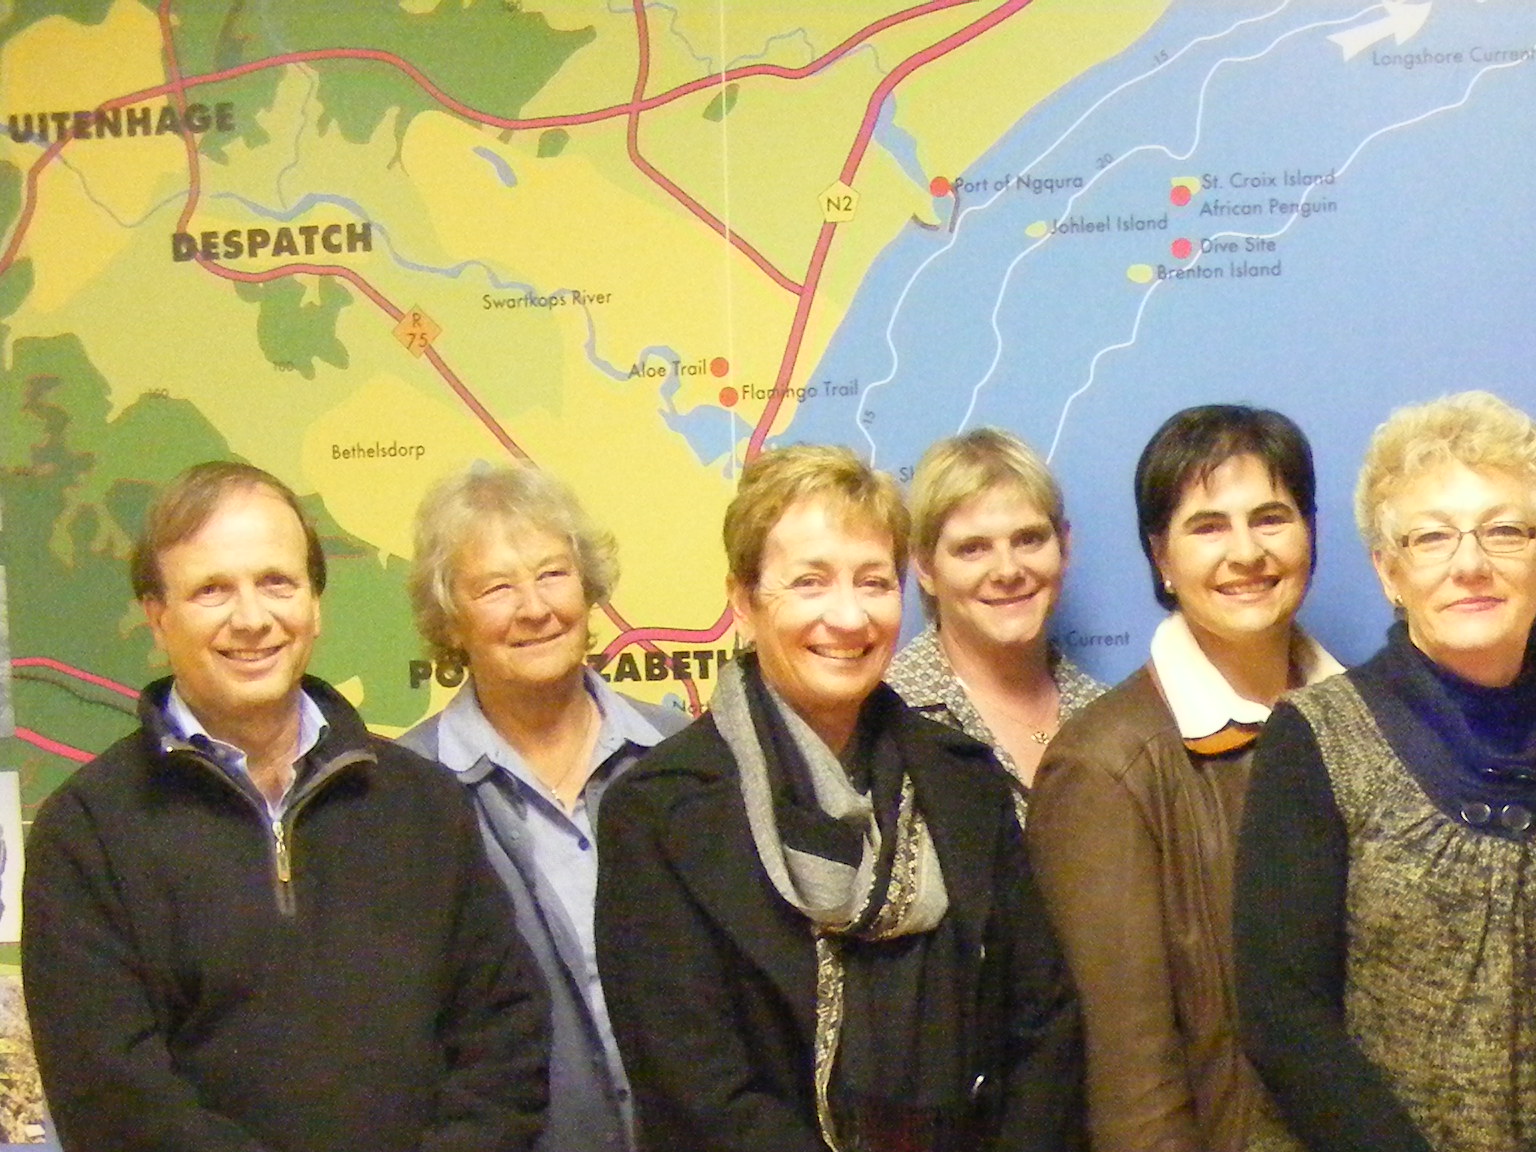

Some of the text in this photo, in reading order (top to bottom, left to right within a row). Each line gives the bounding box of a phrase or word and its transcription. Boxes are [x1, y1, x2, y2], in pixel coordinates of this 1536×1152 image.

[1372, 46, 1536, 70] Longshore Current
[8, 102, 236, 143] UITENHAGE
[954, 174, 1084, 195] Port of Ngqura
[1201, 168, 1336, 190] St. Croix Island
[826, 196, 853, 213] N2
[1200, 198, 1338, 218] African Penguin
[1117, 212, 1168, 232] Island
[172, 222, 373, 262] DESPATCH
[1200, 236, 1277, 254] Dive Site
[1156, 260, 1283, 281] Brenton Island
[482, 289, 613, 311] Swartkops River
[412, 312, 422, 328] R
[406, 332, 429, 349] 75
[627, 358, 708, 380] Aloe Trail
[742, 379, 860, 403] Flamingo Trail
[331, 440, 426, 461] Bethelsdorp
[409, 659, 465, 689] PO
